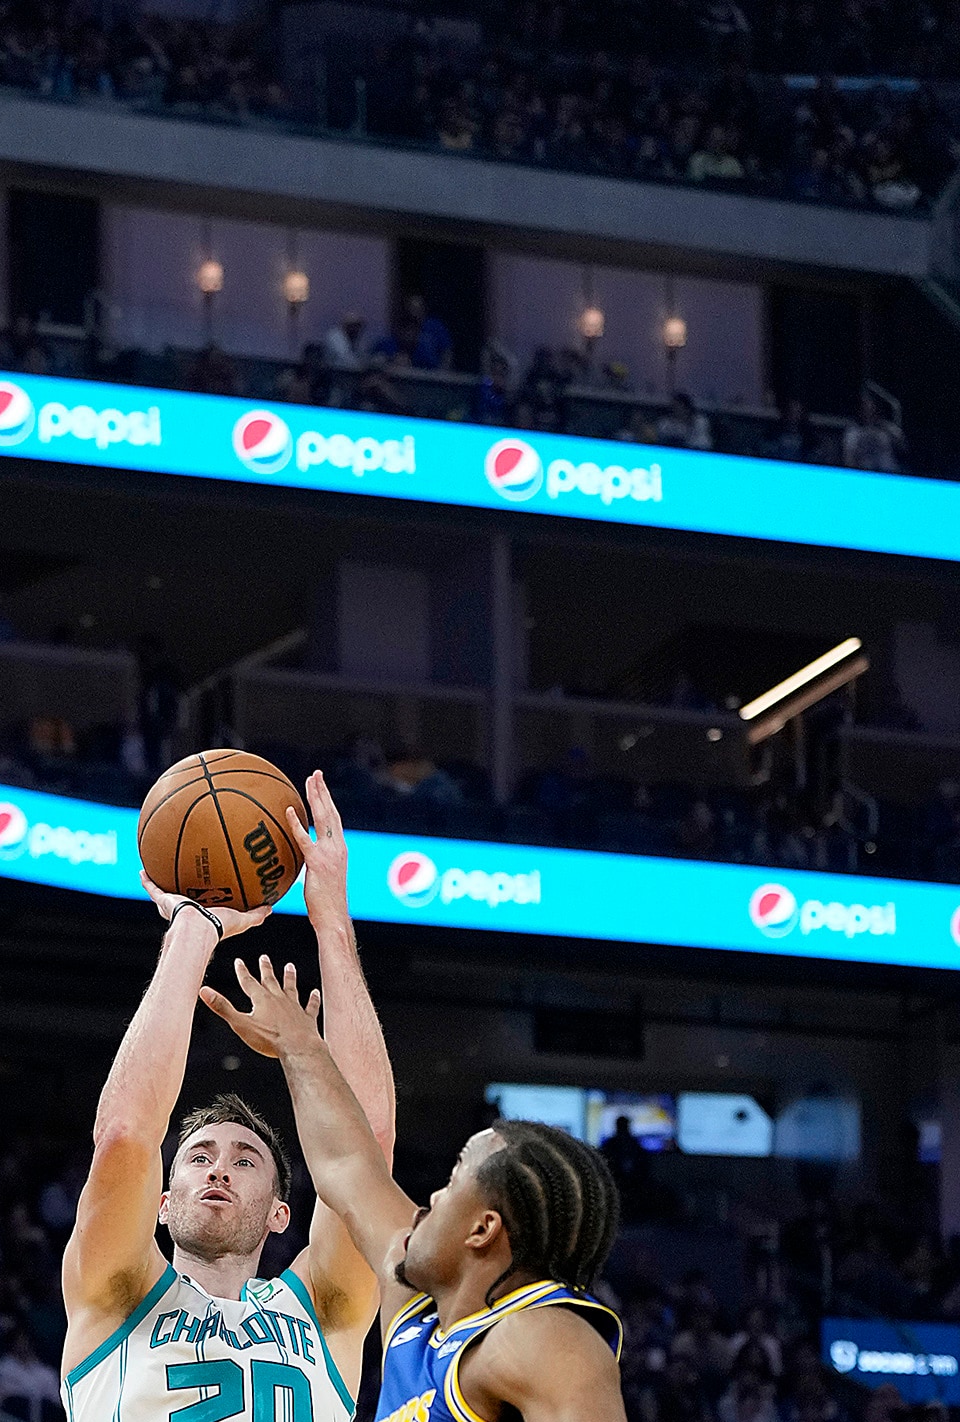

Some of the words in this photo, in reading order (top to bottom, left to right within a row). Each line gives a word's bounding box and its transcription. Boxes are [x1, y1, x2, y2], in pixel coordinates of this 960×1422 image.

[38, 402, 161, 449] pepsi
[296, 431, 416, 476] pepsi
[547, 459, 662, 504] pepsi
[29, 823, 117, 864] pepsi
[440, 868, 541, 907] pepsi
[799, 900, 896, 938] pepsi
